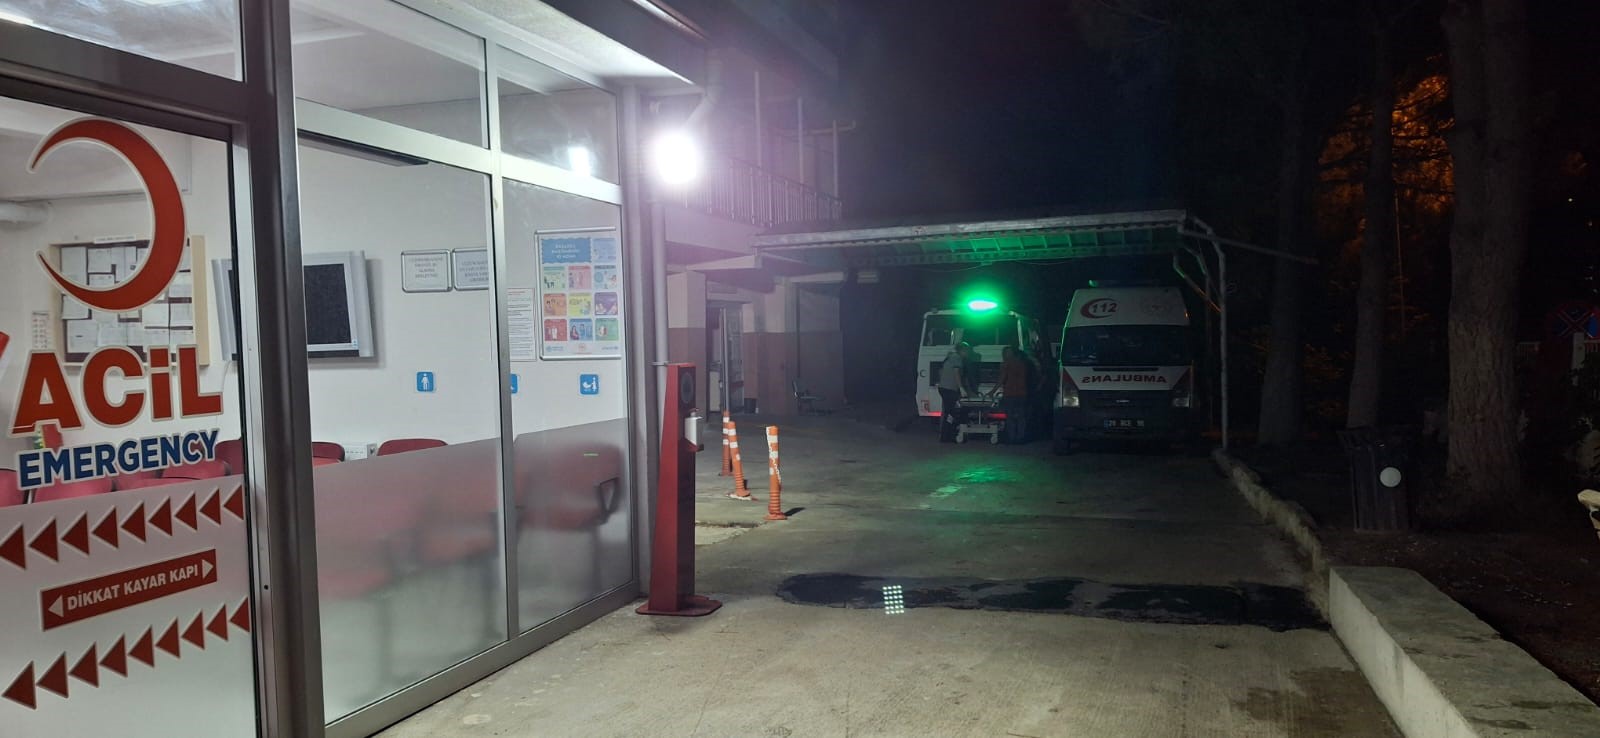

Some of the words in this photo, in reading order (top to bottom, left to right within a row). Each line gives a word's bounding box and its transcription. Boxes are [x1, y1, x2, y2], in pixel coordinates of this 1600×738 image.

[1092, 302, 1118, 314] 112
[11, 346, 222, 434] ACİL
[18, 430, 218, 488] EMERGENCY
[67, 584, 121, 610] DİKKAT
[124, 573, 166, 595] KAYAR
[169, 564, 199, 583] KAPI
